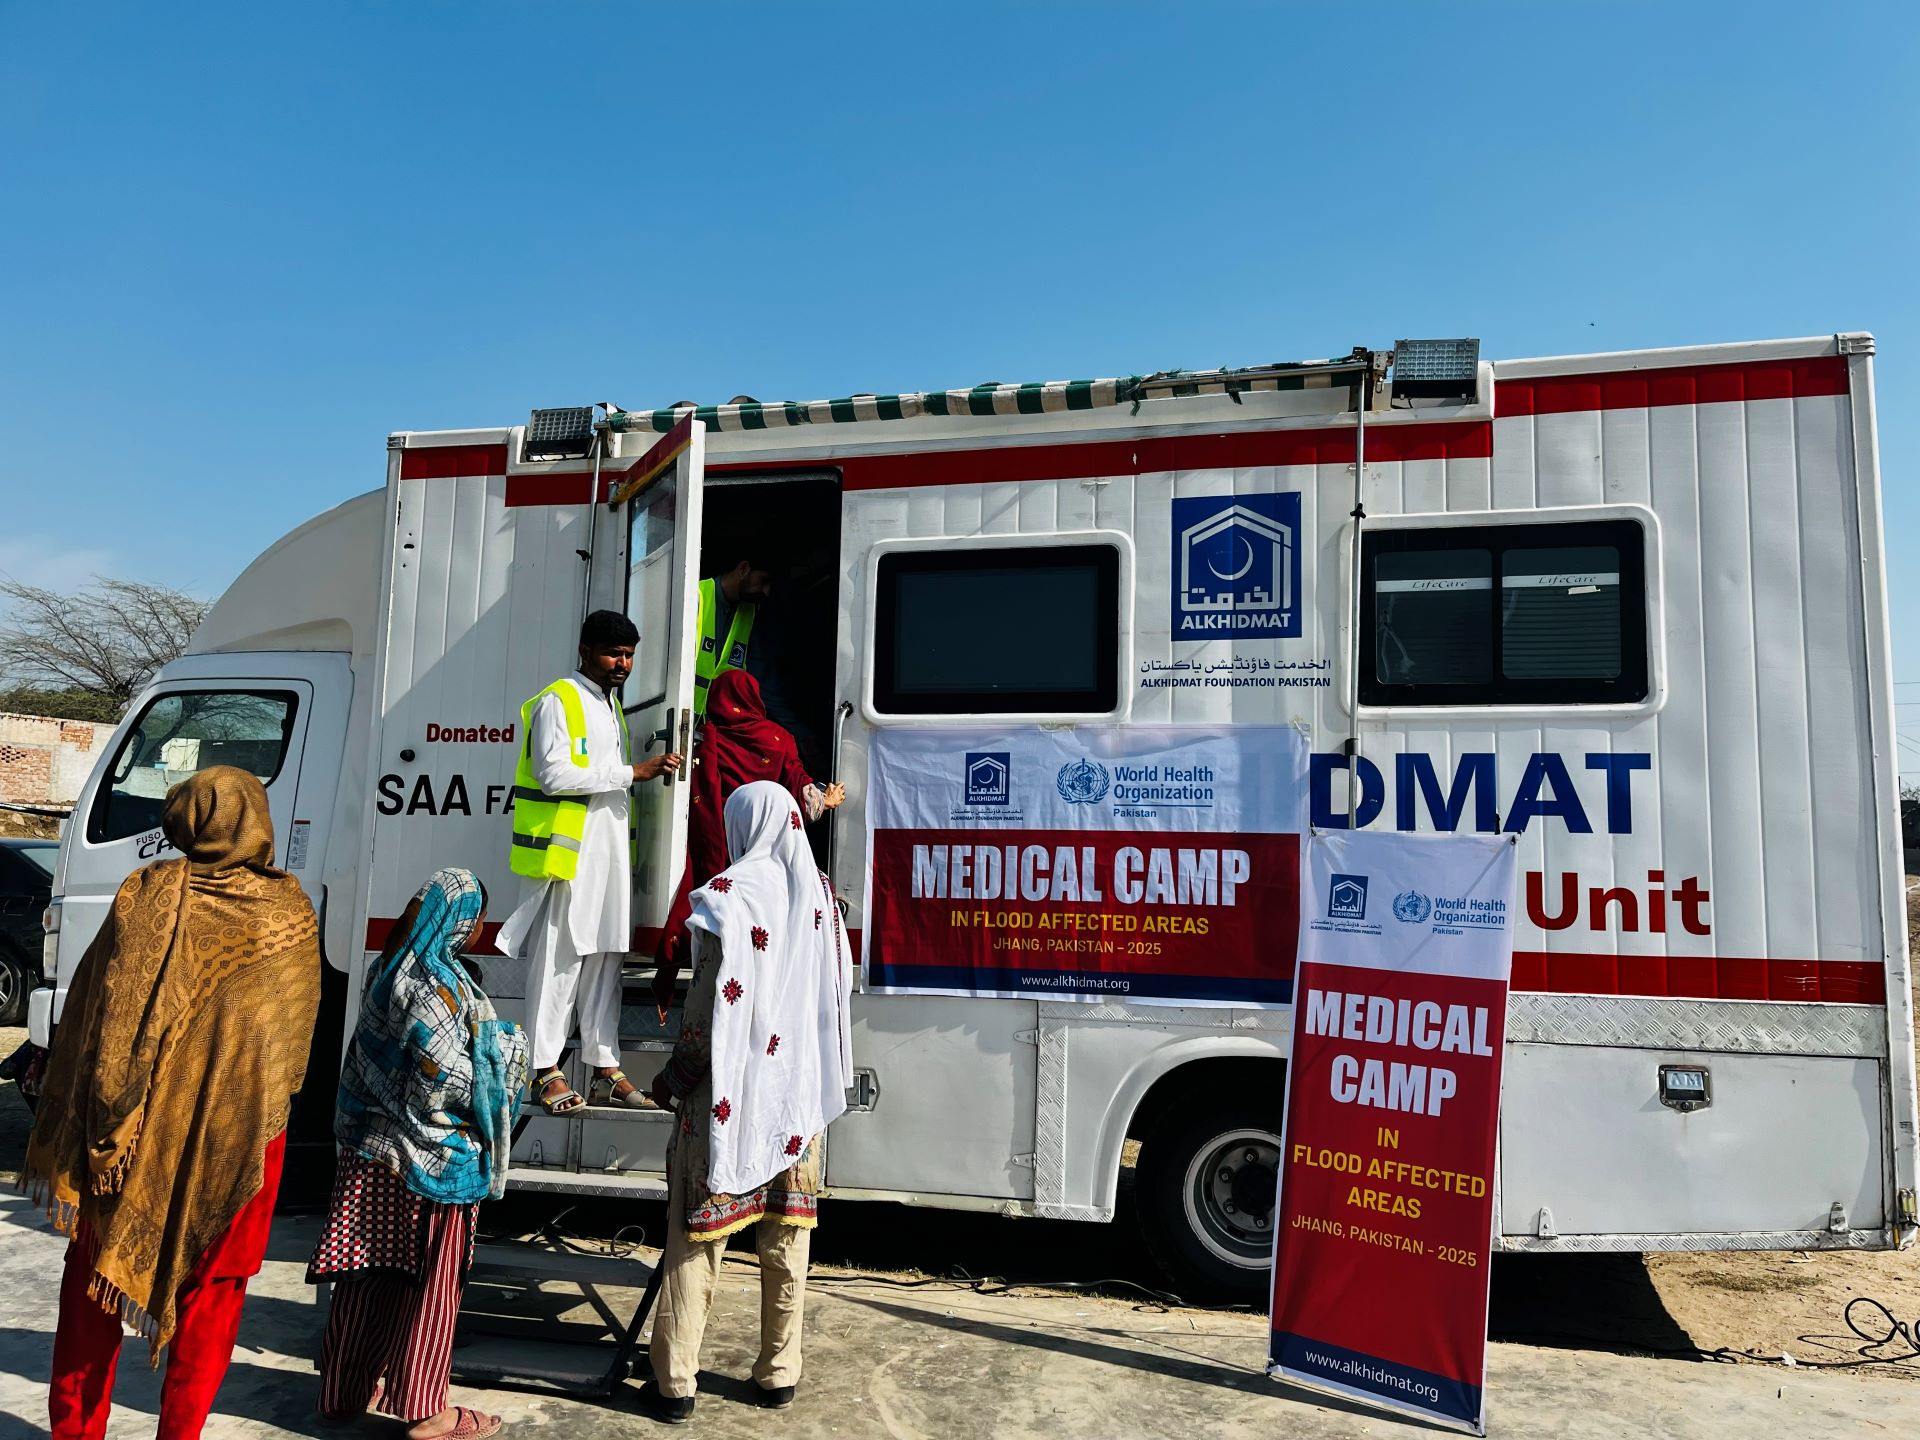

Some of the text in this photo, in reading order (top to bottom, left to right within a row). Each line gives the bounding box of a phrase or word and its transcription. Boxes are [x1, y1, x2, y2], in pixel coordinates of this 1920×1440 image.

[1412, 580, 1469, 590] LifeCare
[1538, 575, 1597, 585] LifeCare
[1181, 613, 1292, 630] ALKHIDMAT
[1140, 677, 1331, 688] ALKHIDMAT FOUNDATION PAKISTAN
[426, 723, 515, 743] Donated
[1114, 766, 1213, 782] World Health
[376, 774, 472, 816] SAA
[1113, 783, 1213, 803] Organization
[1113, 808, 1157, 818] Pakistan
[136, 832, 161, 846] FUSO
[911, 844, 1250, 906] MEDICAL CAMP
[1435, 897, 1506, 912] World Health
[1526, 869, 1711, 936] Unit
[951, 910, 1209, 935] IN FLOOD AFFECTED AREAS
[1433, 909, 1505, 925] Organization
[1432, 927, 1463, 936] Pakistan
[993, 937, 1044, 953] JHANG,
[1047, 939, 1114, 953] PAKISTAN
[1127, 942, 1162, 955] 2025
[1021, 975, 1130, 992] www.alkhidmat.org
[1305, 988, 1494, 1057] MEDICAL
[1330, 1054, 1457, 1117] CAMP
[1377, 1127, 1400, 1149] IN
[1293, 1144, 1486, 1198] FLOOD AFFECTED
[1347, 1186, 1422, 1219] AREAS
[1292, 1214, 1346, 1239] JHANG,
[1350, 1225, 1423, 1256] PAKISTAN
[1437, 1245, 1477, 1267] 2025
[1305, 1351, 1439, 1403] www.alkhidmat.org
